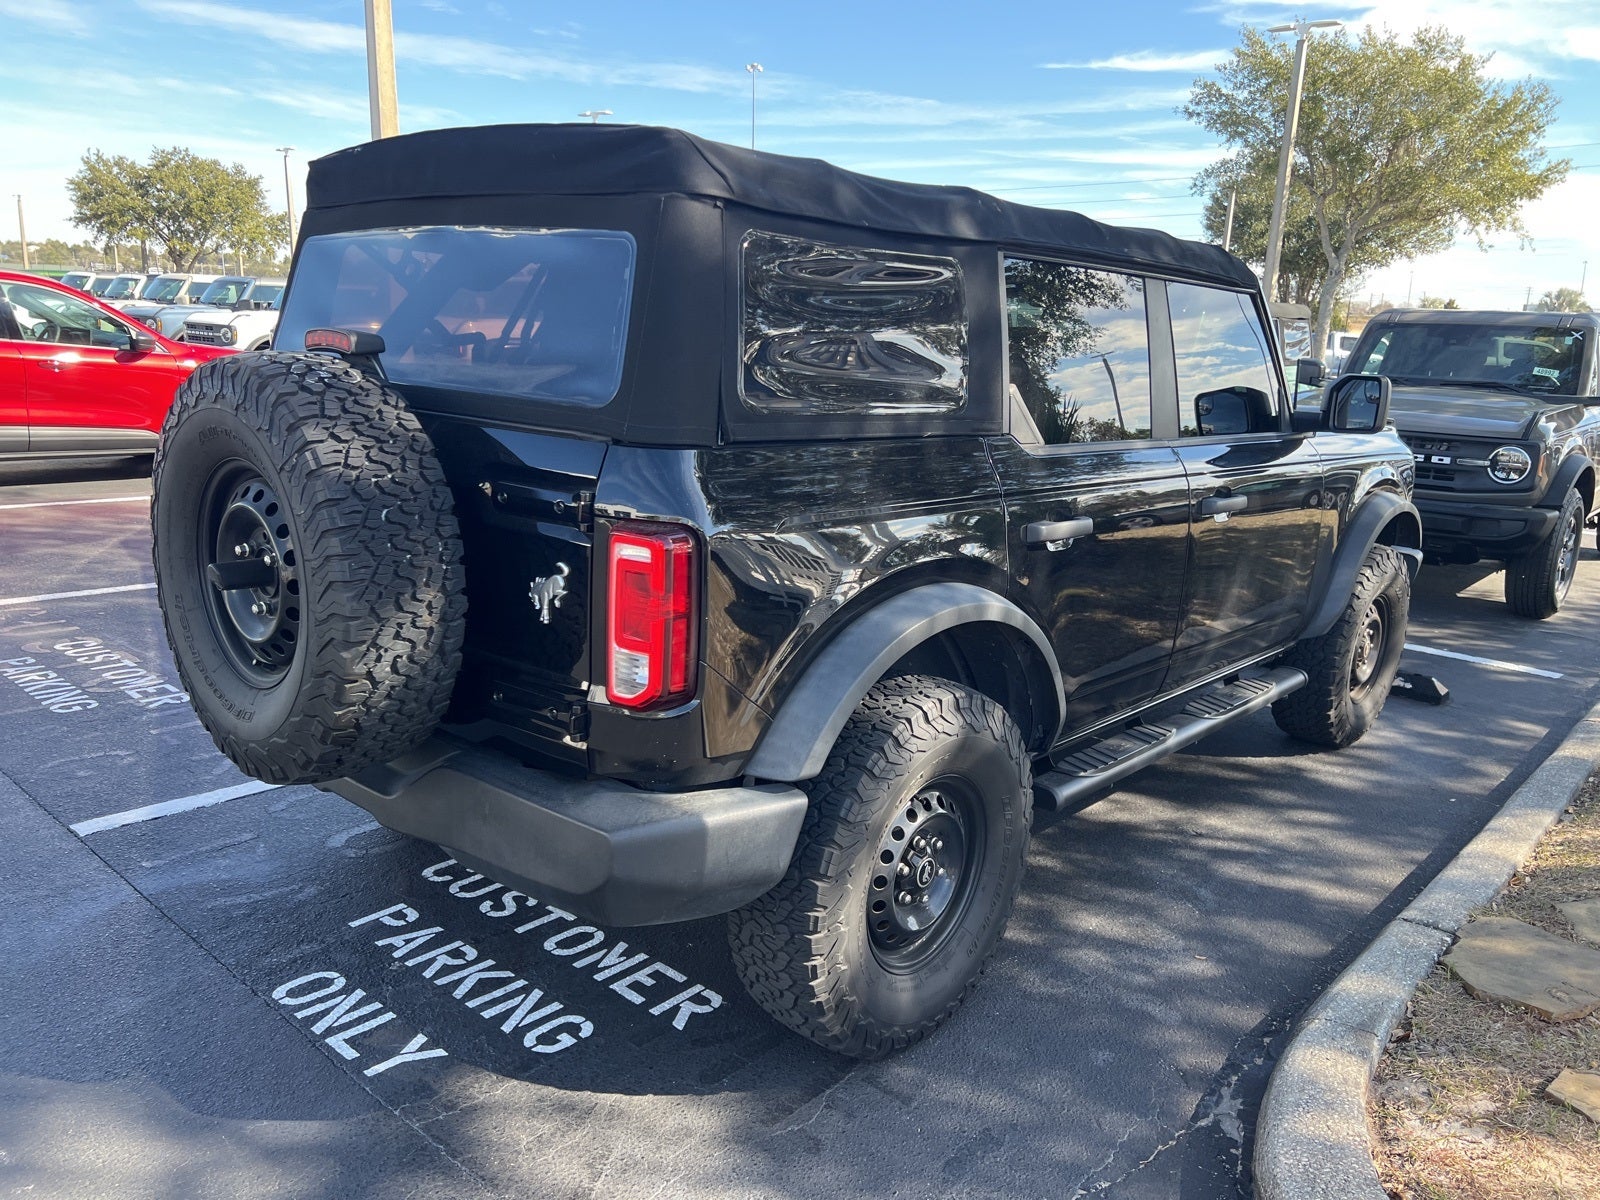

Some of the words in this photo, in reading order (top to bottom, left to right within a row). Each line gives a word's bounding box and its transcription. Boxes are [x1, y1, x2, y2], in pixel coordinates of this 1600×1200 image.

[0, 656, 98, 713] PARKING
[53, 639, 191, 708] CUSTOMER
[348, 903, 594, 1054] PARKING
[421, 859, 723, 1031] CUSTOMER
[271, 971, 448, 1077] ONLY
